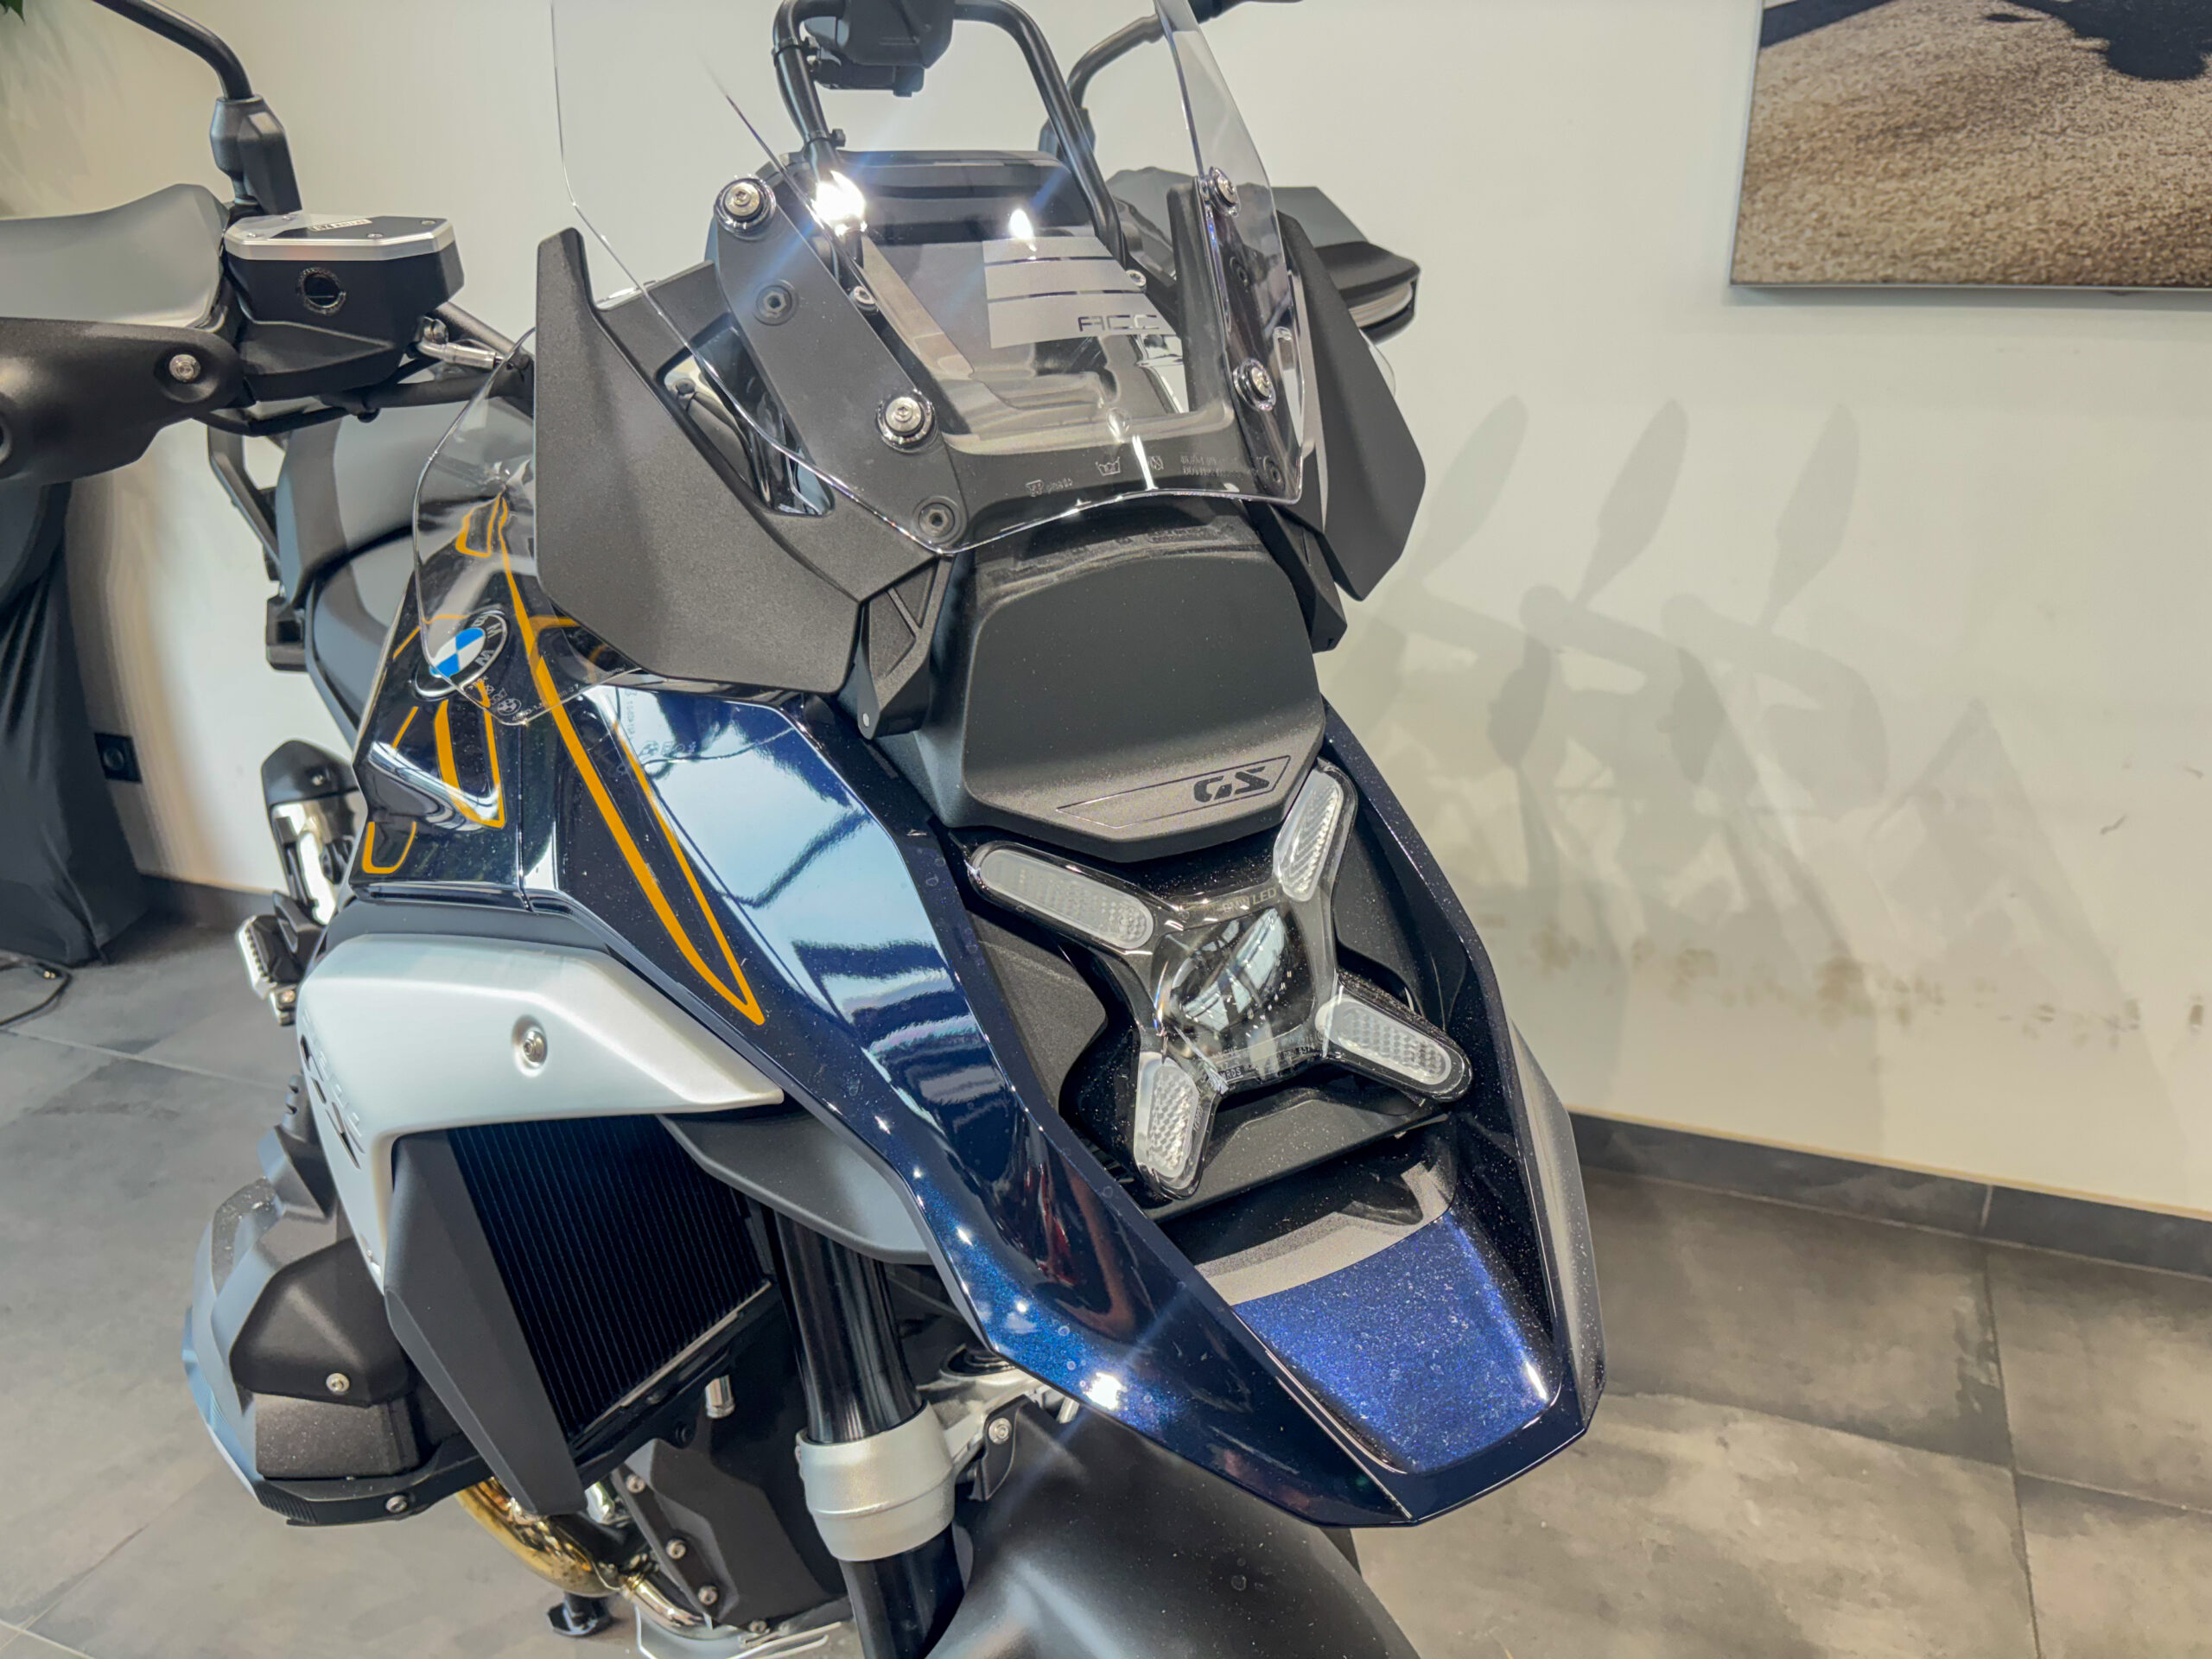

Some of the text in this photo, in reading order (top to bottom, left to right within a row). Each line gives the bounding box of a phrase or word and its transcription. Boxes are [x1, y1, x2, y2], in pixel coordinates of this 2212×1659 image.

[1077, 315, 1160, 332] ACC
[471, 615, 503, 667] BMW
[1193, 766, 1270, 803] GS
[1222, 887, 1277, 913] BMW LED
